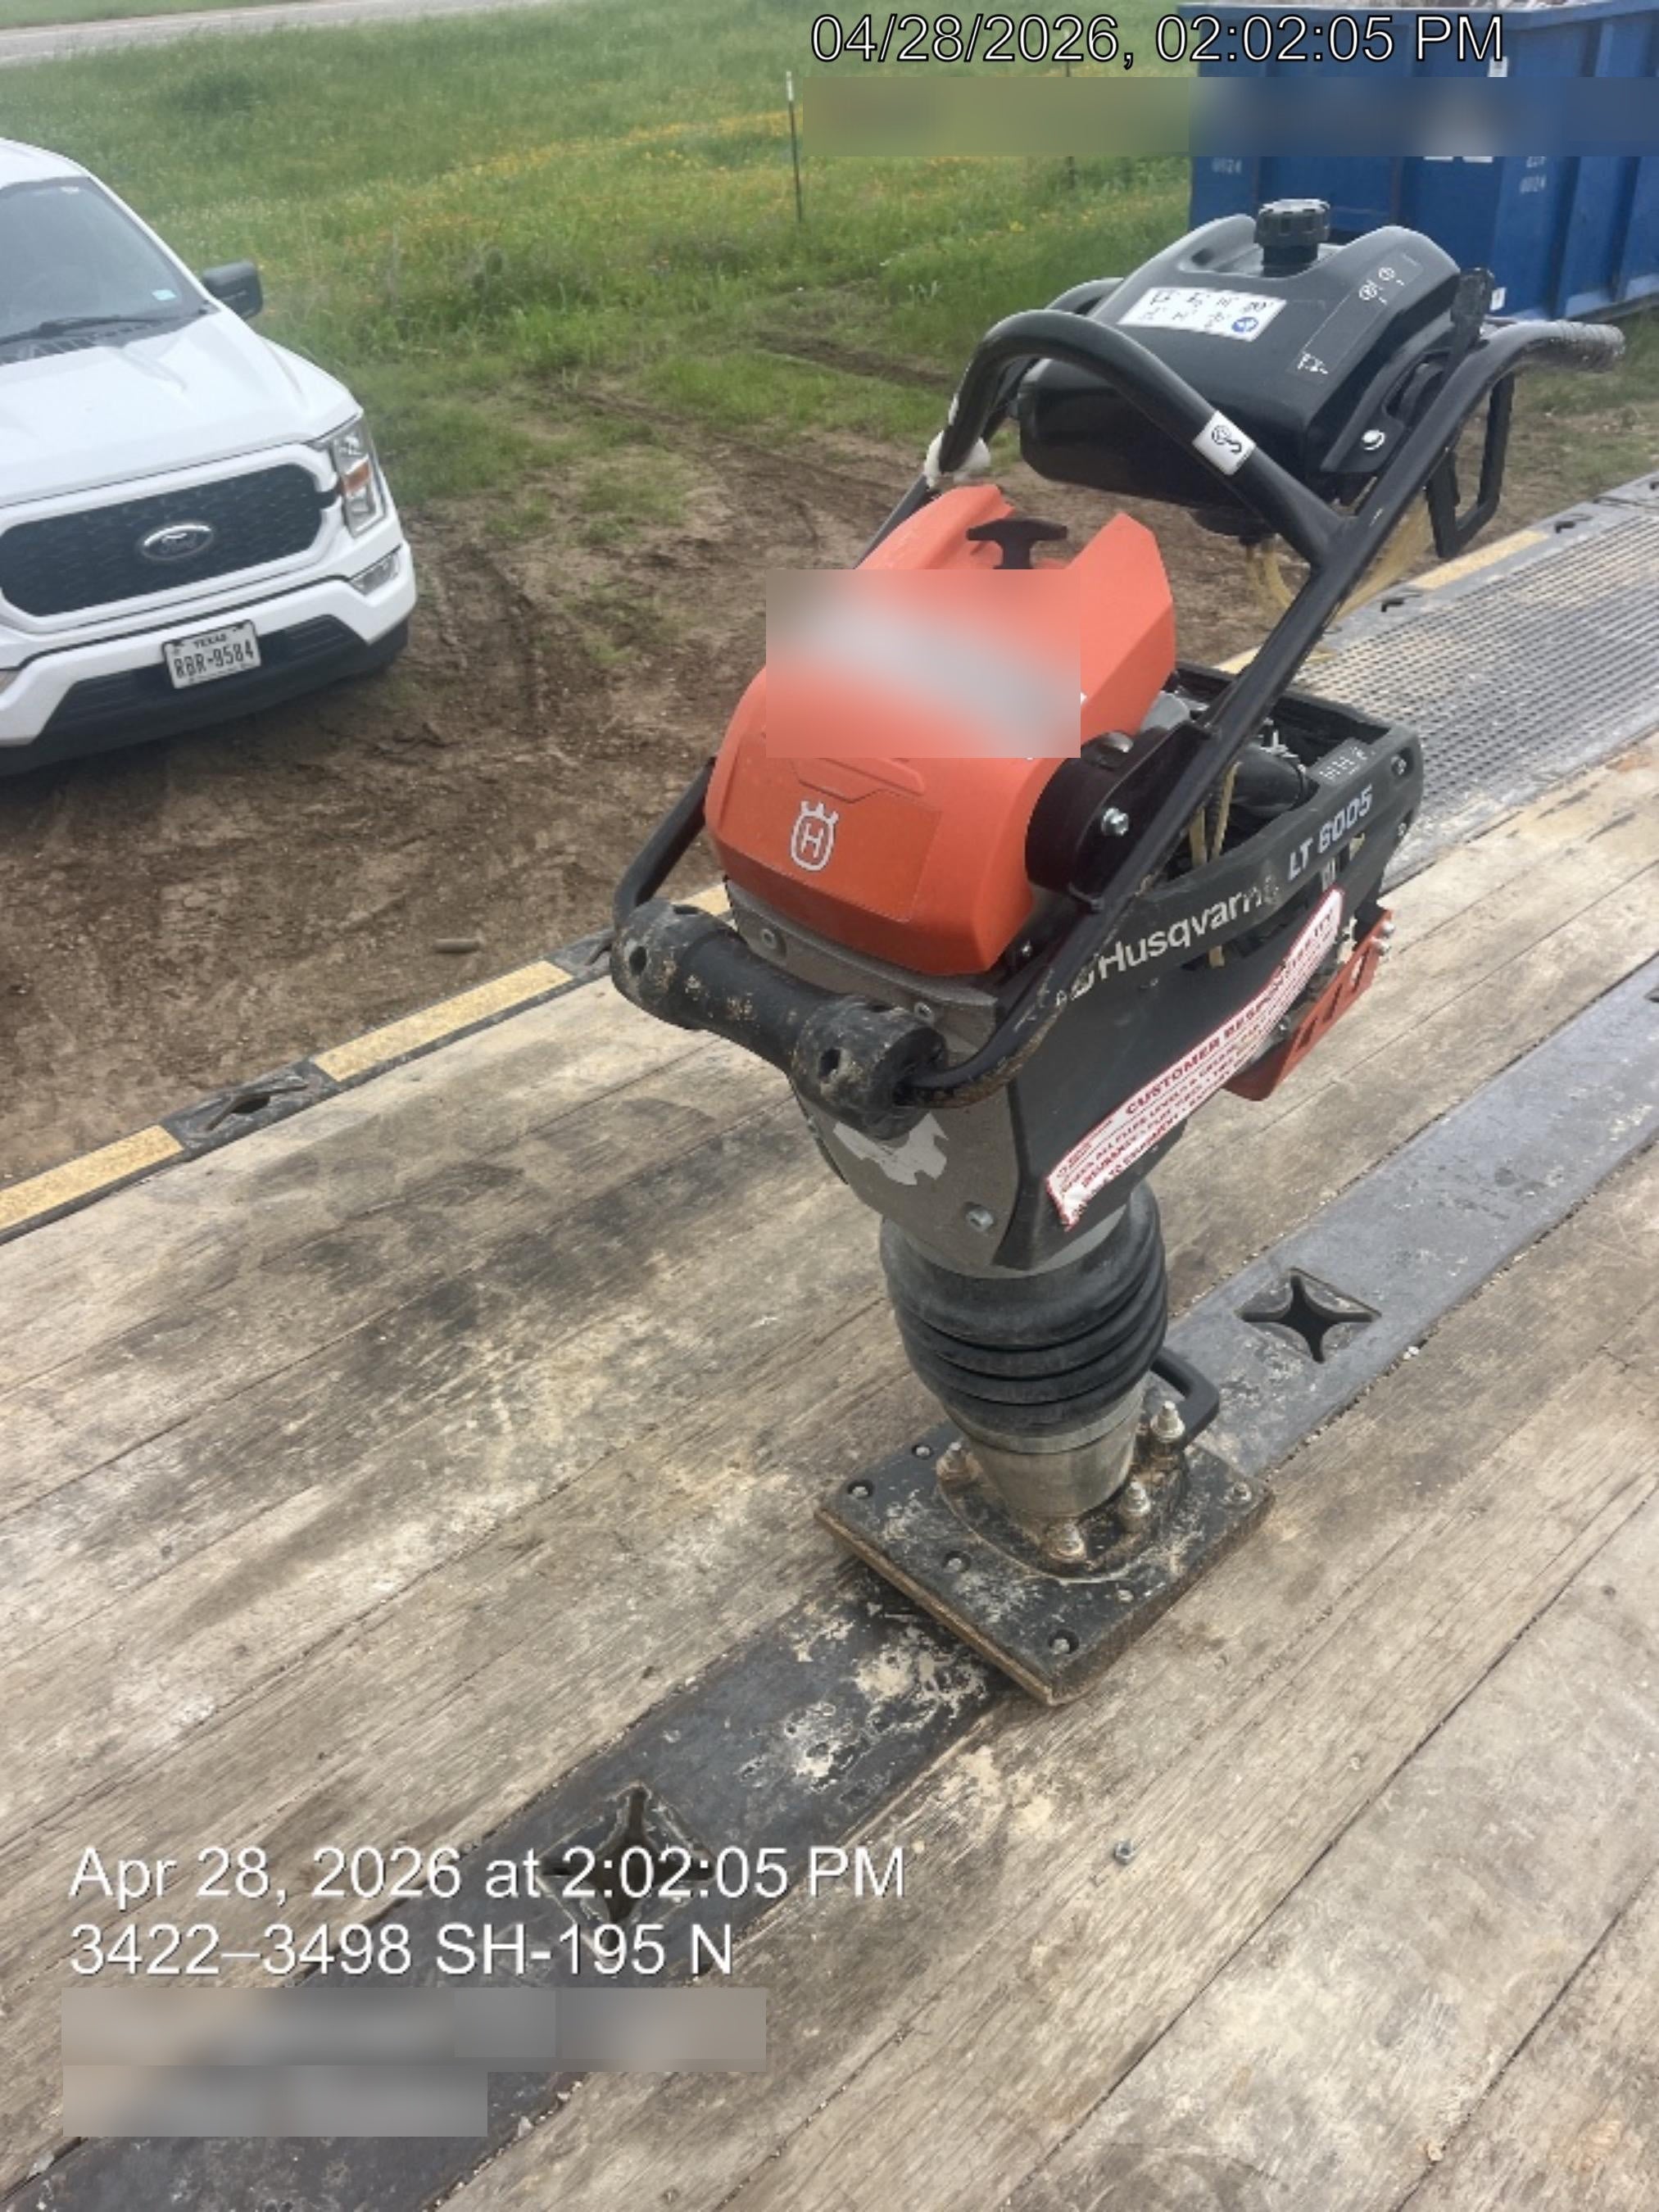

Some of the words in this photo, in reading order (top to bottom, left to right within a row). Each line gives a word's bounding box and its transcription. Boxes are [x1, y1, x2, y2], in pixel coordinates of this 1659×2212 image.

[1288, 836, 1314, 882] LT
[1317, 784, 1373, 854] 6005
[1125, 1036, 1221, 1115] CUSTOMER
